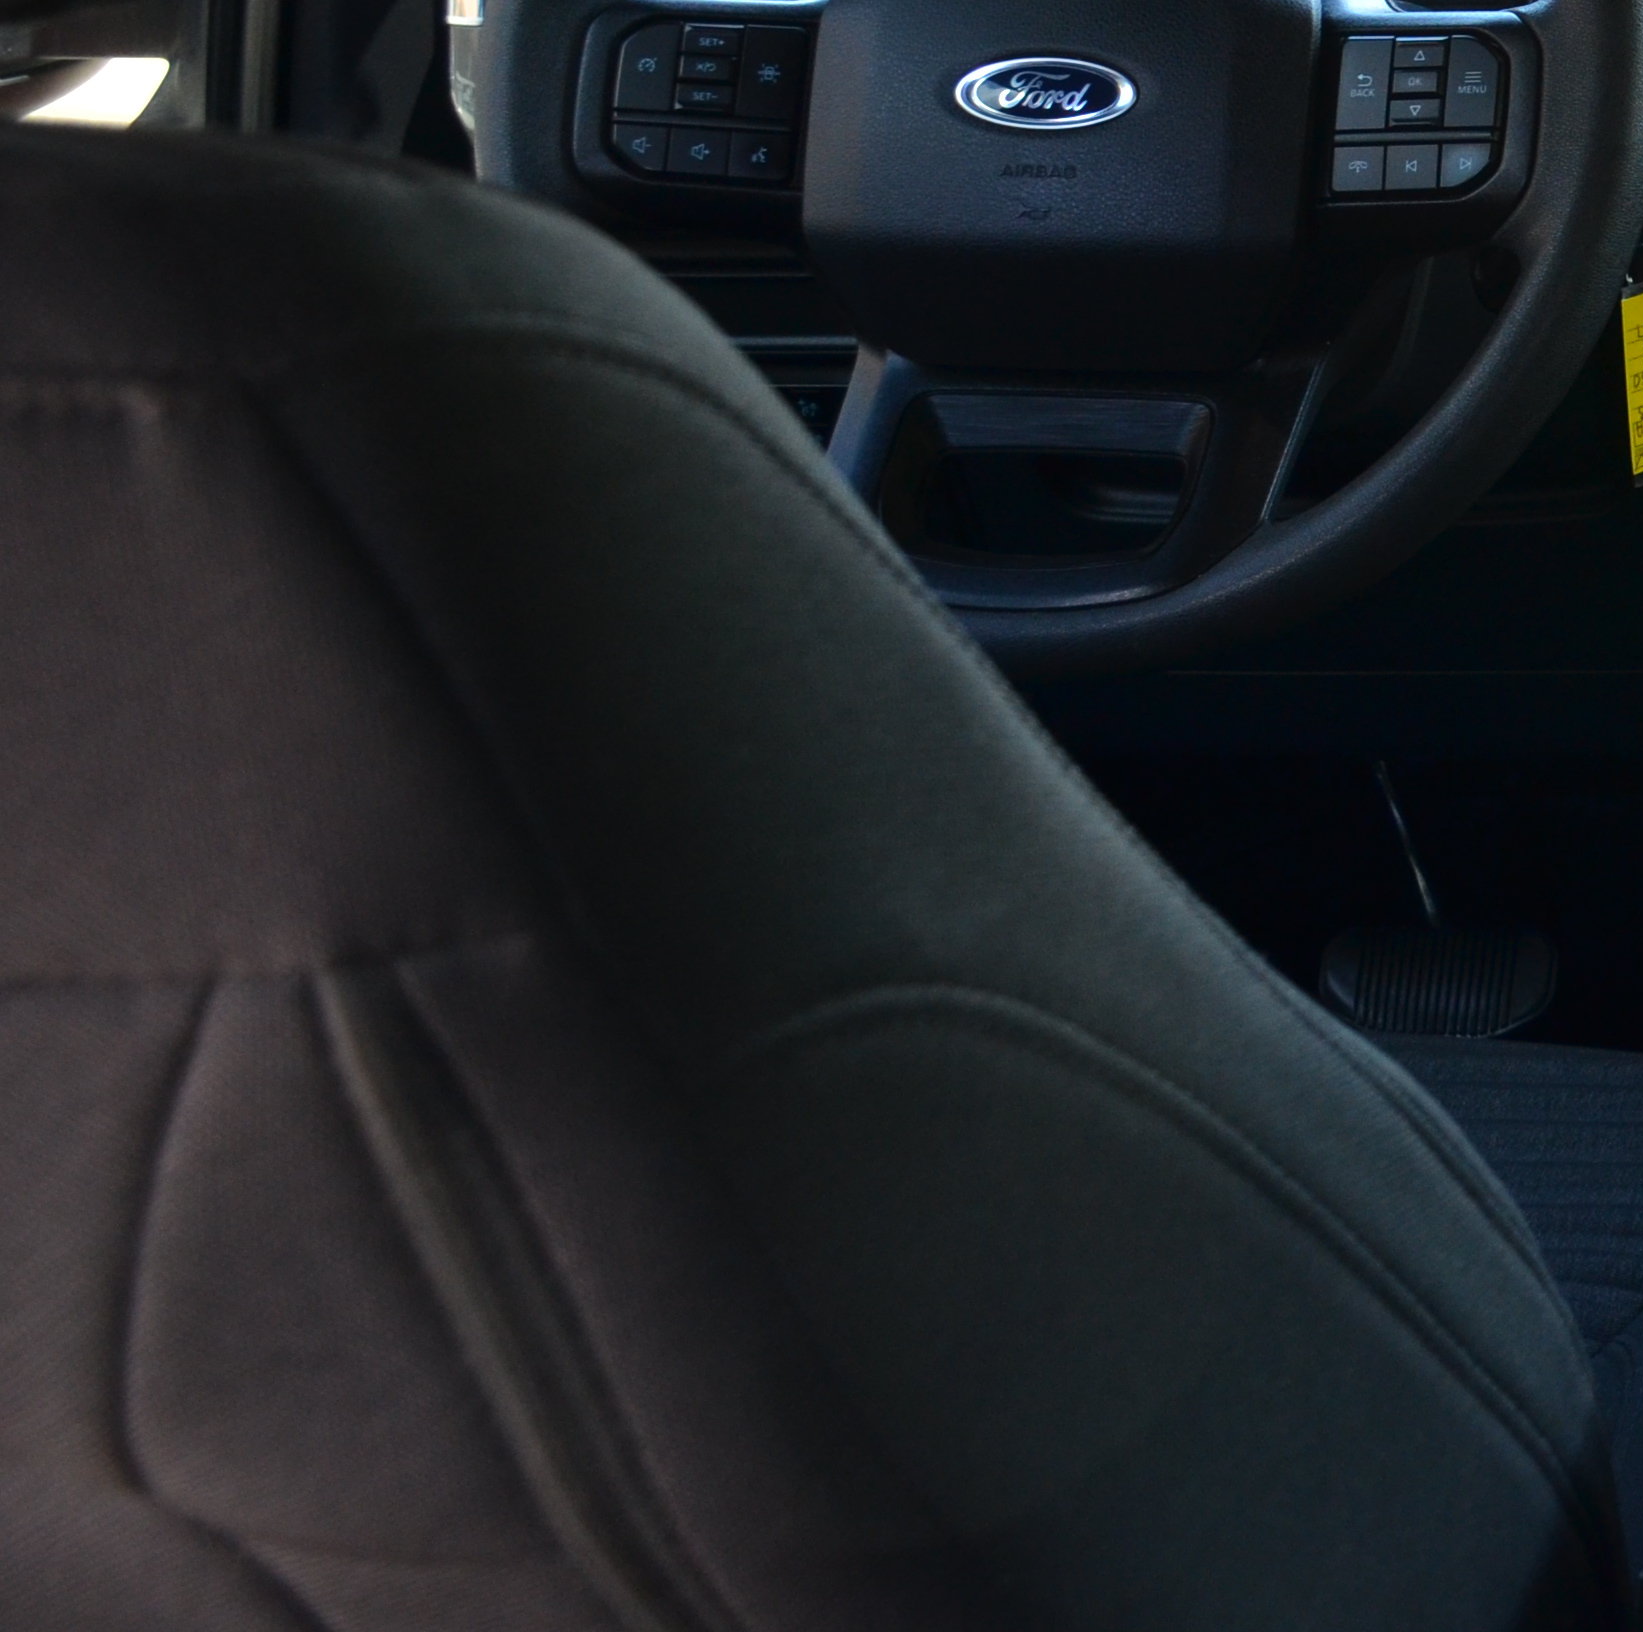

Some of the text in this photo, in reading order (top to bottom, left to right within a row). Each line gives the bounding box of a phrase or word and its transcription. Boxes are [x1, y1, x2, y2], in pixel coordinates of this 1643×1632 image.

[1408, 77, 1422, 86] OK
[997, 70, 1091, 112] Ford
[1350, 88, 1375, 98] BACK
[1457, 85, 1487, 94] MENU
[1001, 164, 1077, 179] AIRBAG
